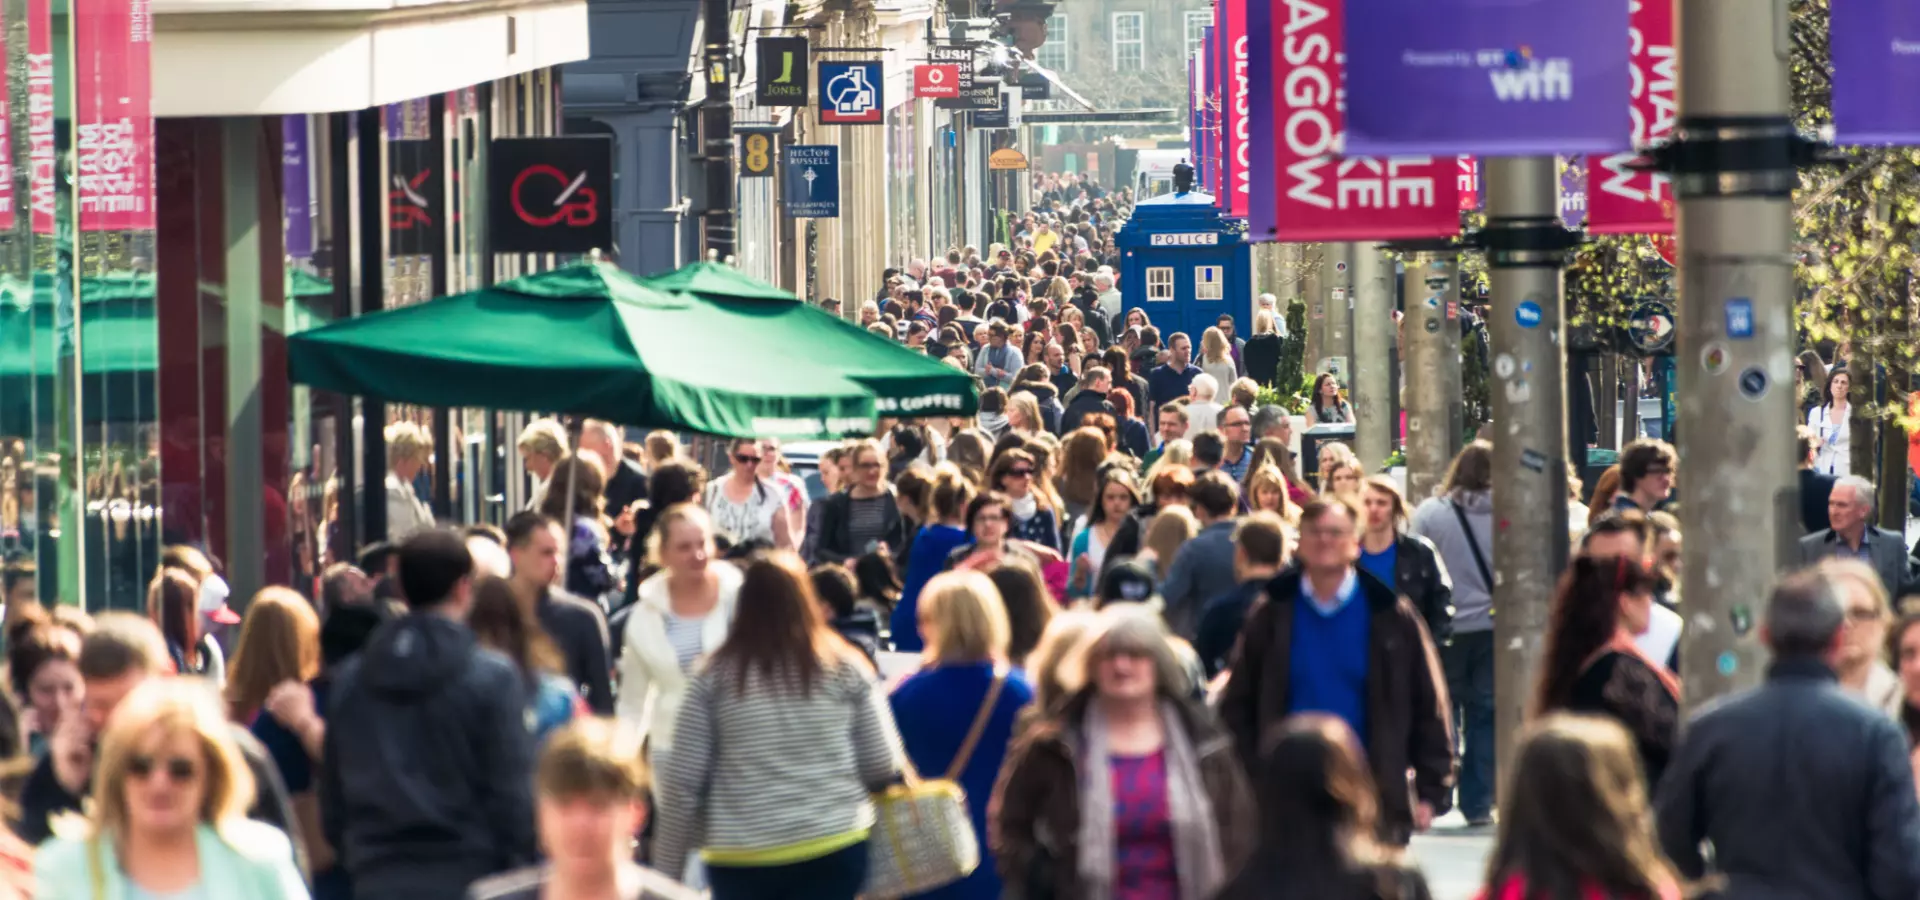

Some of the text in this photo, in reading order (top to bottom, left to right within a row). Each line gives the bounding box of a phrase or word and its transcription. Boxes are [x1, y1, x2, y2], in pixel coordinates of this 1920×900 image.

[931, 49, 972, 60] LUSH
[1490, 58, 1572, 101] wifi
[920, 85, 953, 93] vodafone
[1283, 0, 1333, 209] ASGOW
[790, 148, 830, 157] HECTOR
[790, 157, 831, 165] RUSSELL
[1154, 233, 1213, 245] POLICE
